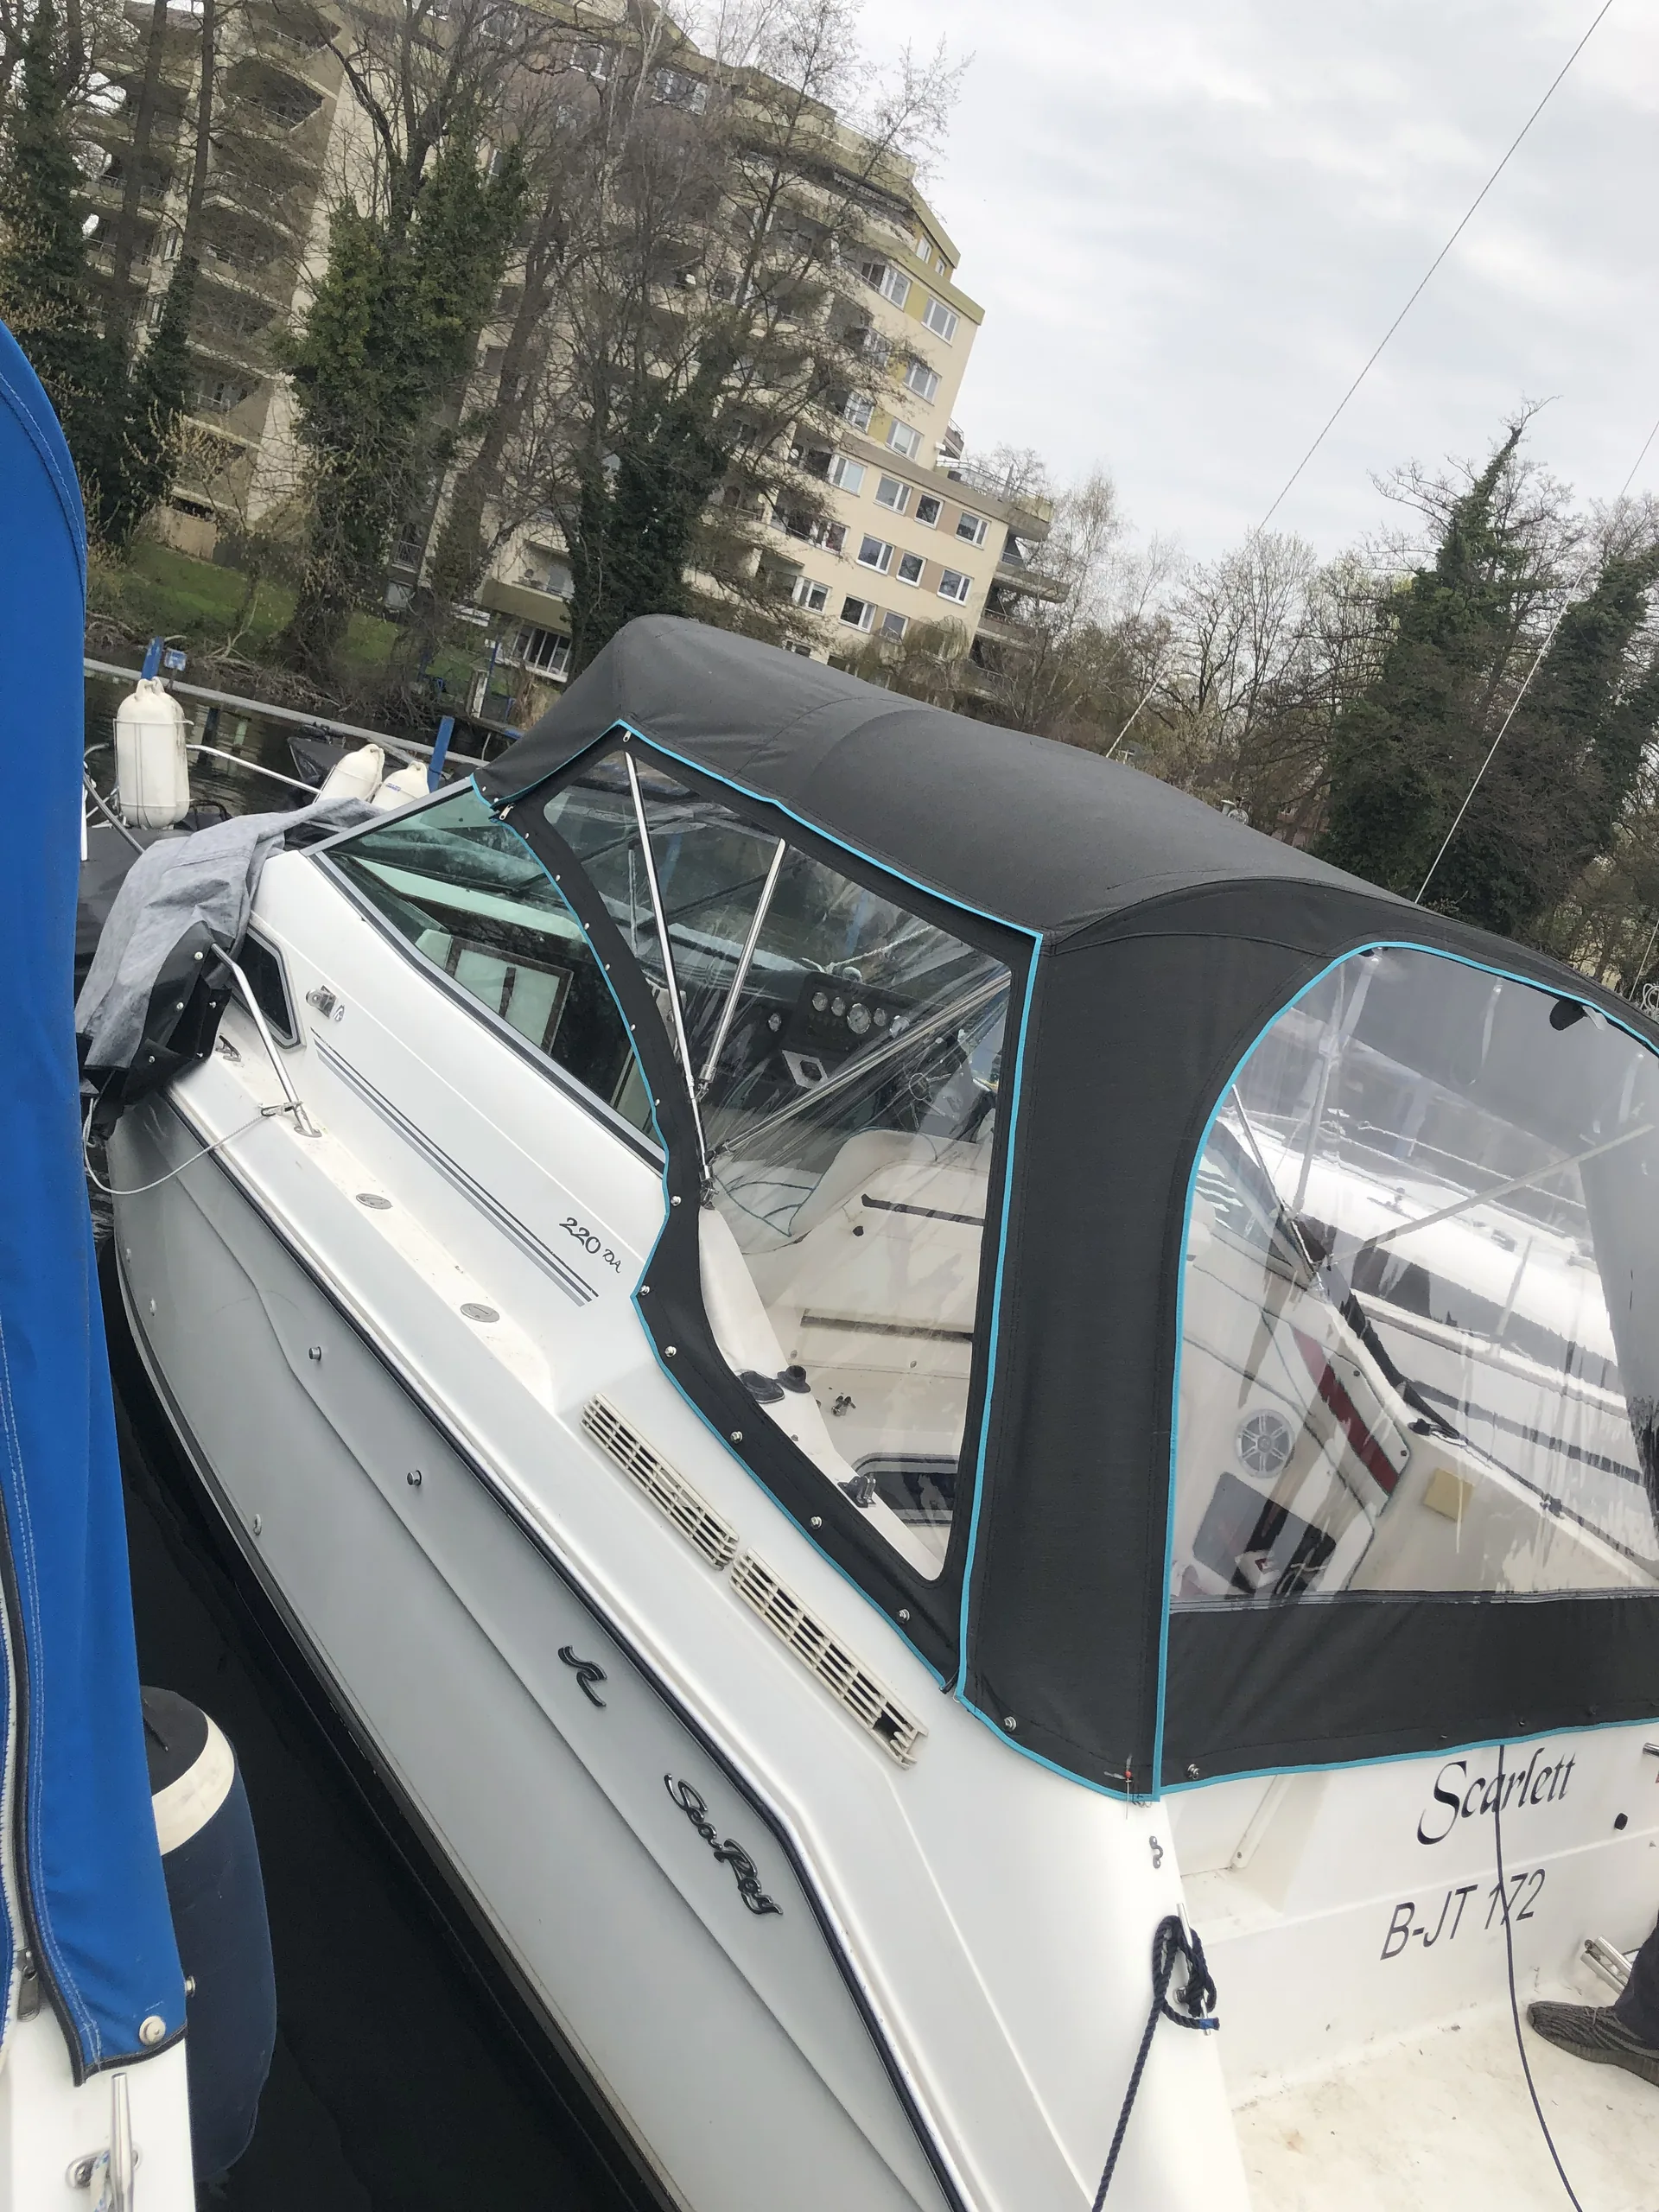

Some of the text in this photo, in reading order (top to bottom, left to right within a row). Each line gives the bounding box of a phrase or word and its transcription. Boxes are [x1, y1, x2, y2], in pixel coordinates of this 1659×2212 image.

[558, 1217, 601, 1254] 220
[1417, 1747, 1576, 1845] Scarlett
[1380, 1868, 1546, 1961] B-JT 172
